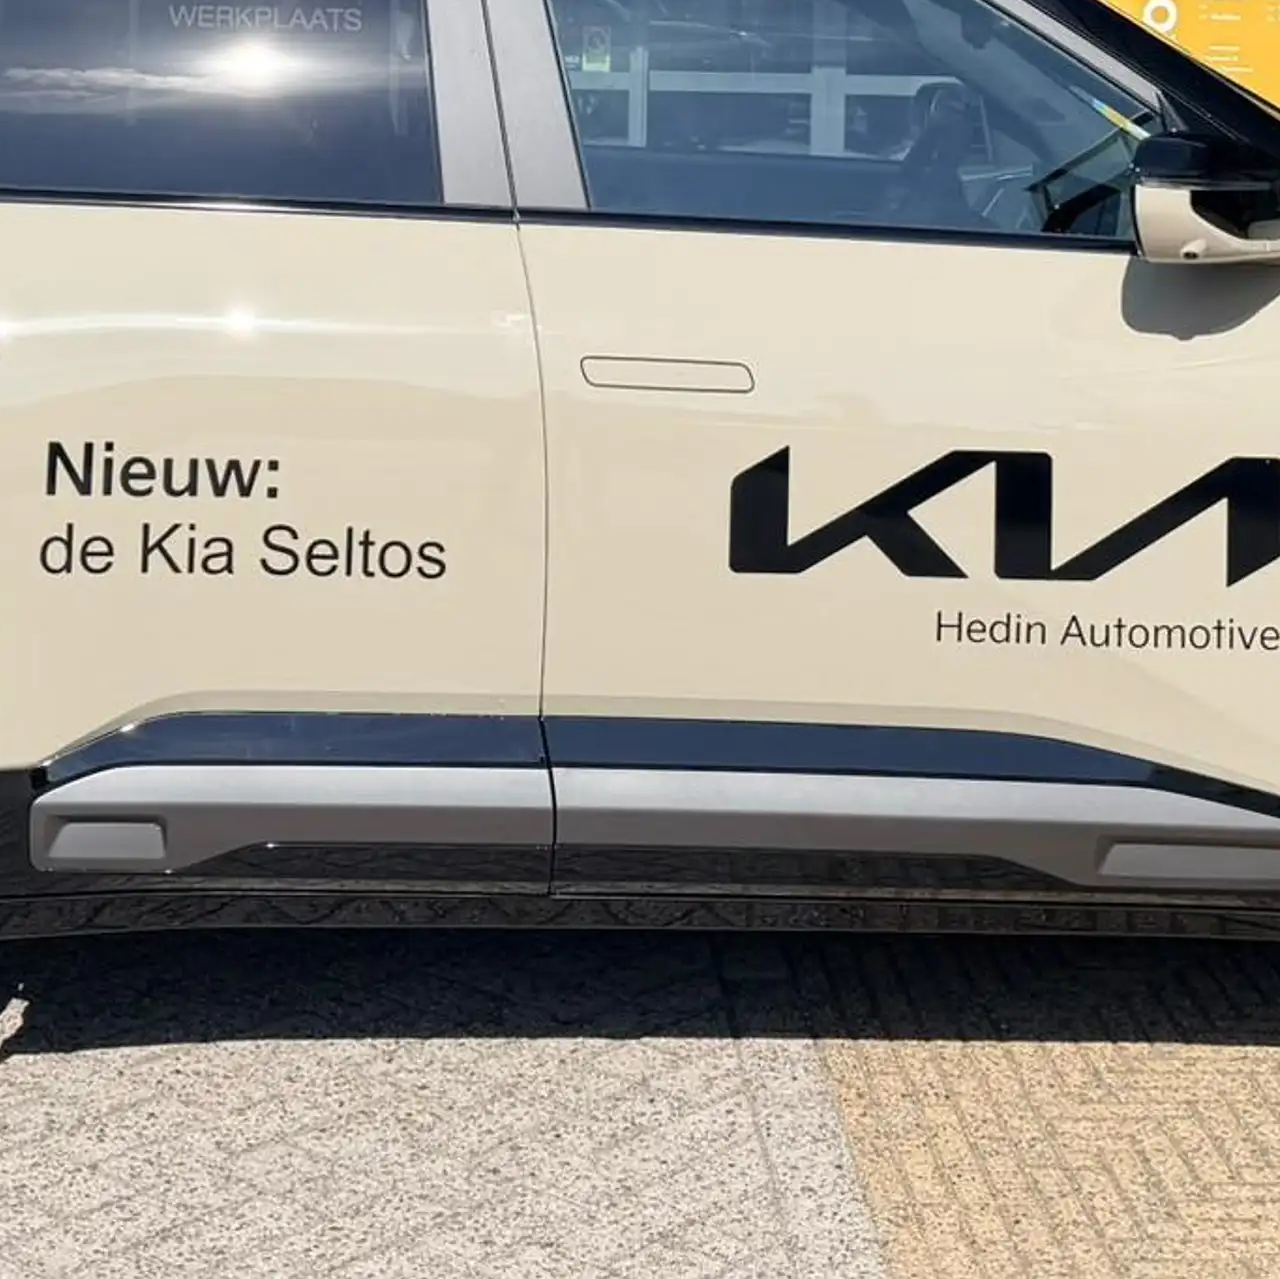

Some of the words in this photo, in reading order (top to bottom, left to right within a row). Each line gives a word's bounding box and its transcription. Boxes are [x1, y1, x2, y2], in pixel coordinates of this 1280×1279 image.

[167, 5, 363, 32] WERKPLAATS
[46, 441, 280, 499] Nieuw:
[40, 523, 115, 574] de
[140, 523, 235, 575] Kia
[260, 524, 447, 579] Seltos
[935, 610, 1047, 645] Hedin
[1061, 615, 1280, 651] Automotive
